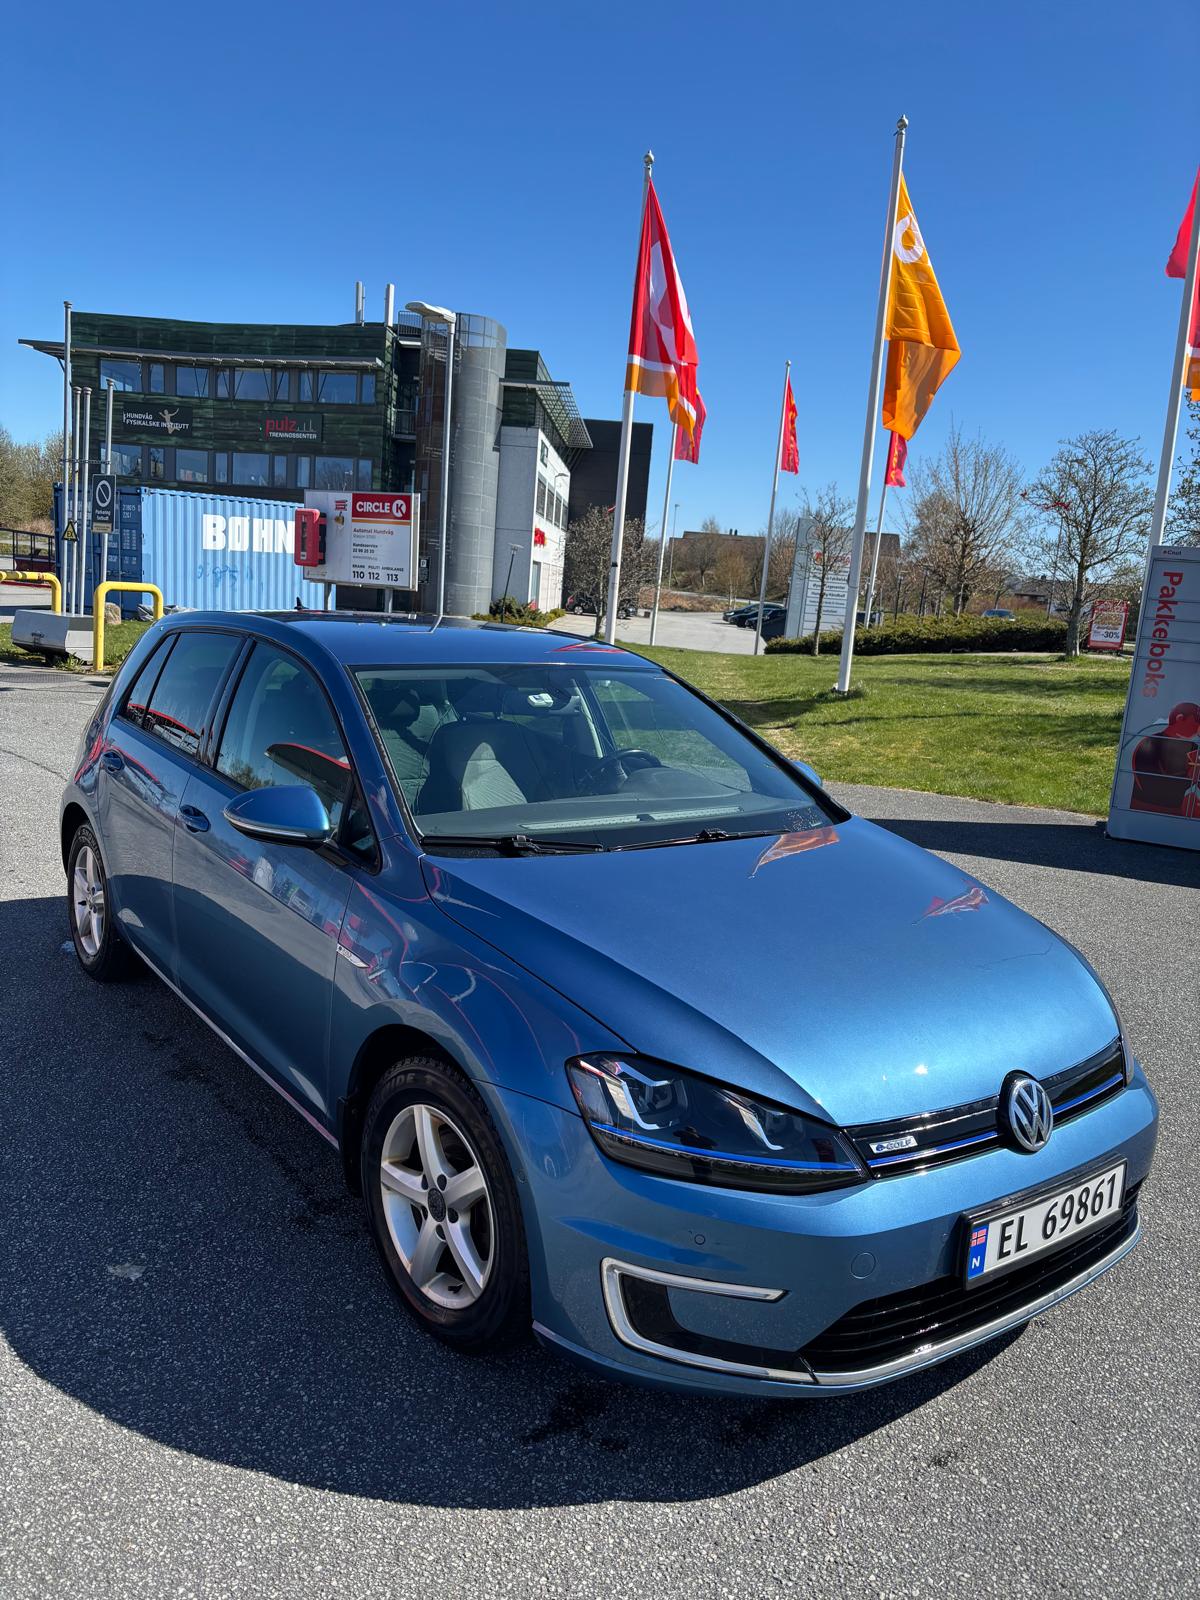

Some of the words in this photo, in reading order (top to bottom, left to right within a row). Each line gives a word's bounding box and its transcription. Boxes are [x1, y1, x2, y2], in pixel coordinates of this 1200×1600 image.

[126, 412, 153, 420] HUNDVÅG
[126, 419, 160, 428] FYSIKALSKE
[266, 416, 297, 440] pulz
[356, 502, 390, 513] CIRCLE
[393, 500, 406, 517] K
[352, 570, 365, 579] 110
[368, 571, 380, 580] 112
[386, 573, 399, 582] 113
[1142, 571, 1184, 698] Pakkeboks
[971, 1256, 980, 1269] N
[997, 1215, 1029, 1261] EL
[1041, 1173, 1117, 1241] 69861
